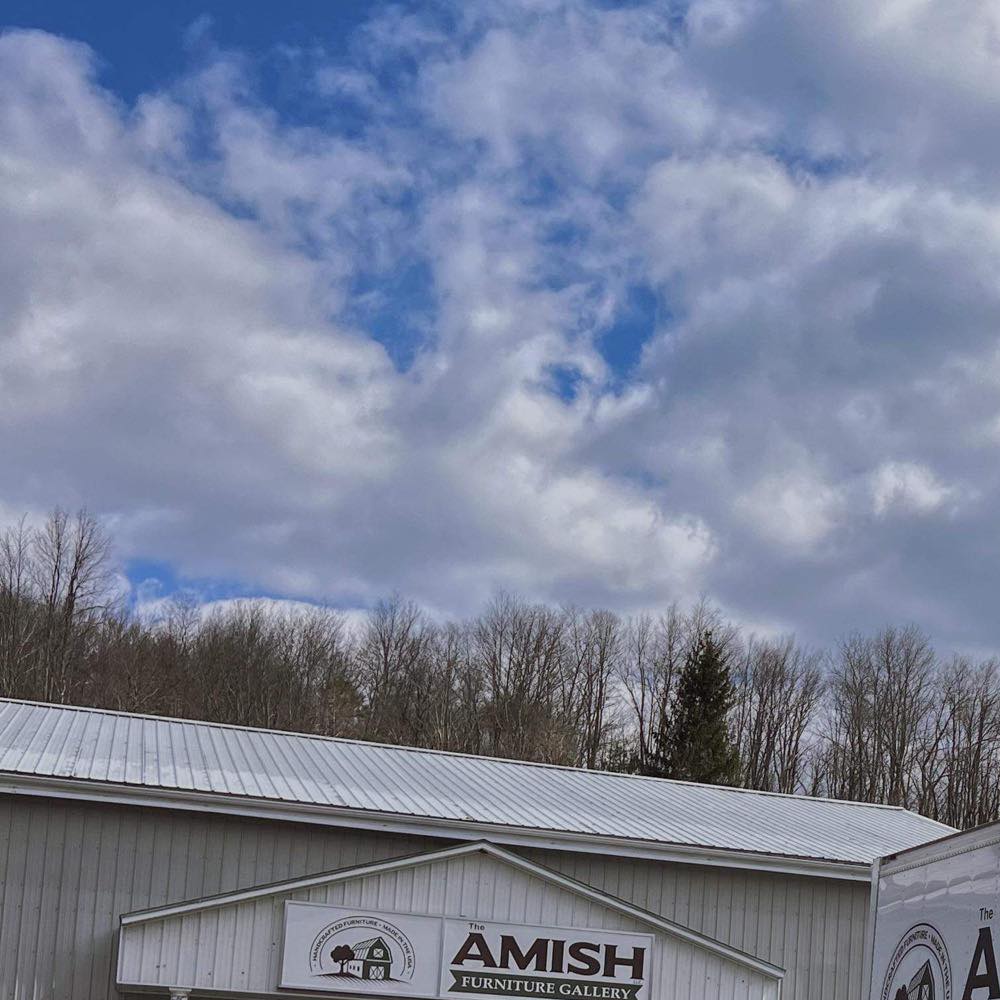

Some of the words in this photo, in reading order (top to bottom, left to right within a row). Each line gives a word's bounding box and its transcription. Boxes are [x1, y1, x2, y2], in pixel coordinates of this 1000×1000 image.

[979, 907, 994, 921] The
[469, 922, 485, 931] The
[313, 922, 343, 961] HANDCRAFTED
[343, 919, 378, 927] FURNITURE
[383, 924, 398, 937] MADE
[402, 941, 411, 955] THE
[451, 932, 647, 980] AMISH
[461, 976, 555, 994] FURNITURE
[559, 984, 631, 1000] GALLERY
